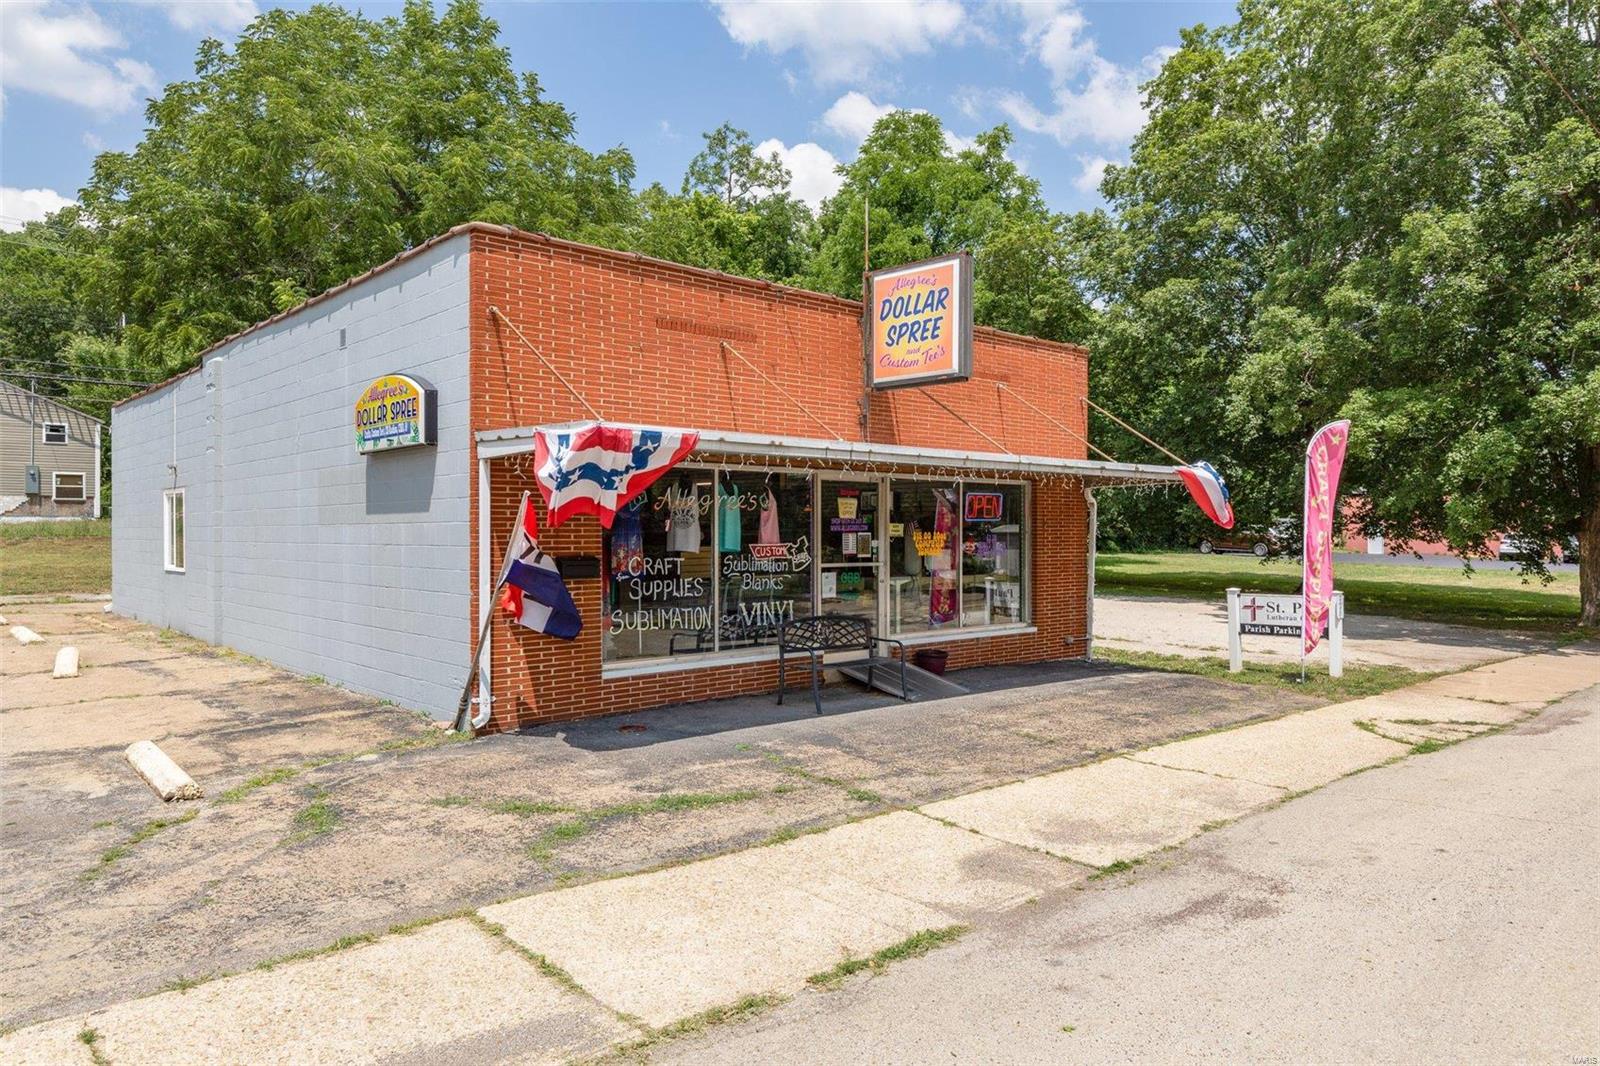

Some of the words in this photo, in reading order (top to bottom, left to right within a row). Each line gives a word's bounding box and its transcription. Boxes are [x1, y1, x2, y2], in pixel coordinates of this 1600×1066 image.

[880, 287, 950, 322] DOLLAR
[885, 316, 944, 347] SPREE
[880, 353, 919, 368] Custom
[922, 345, 945, 364] Tee's
[356, 404, 388, 427] DOLLAR
[390, 397, 417, 420] SPREE
[968, 494, 1001, 518] OPEN
[754, 546, 786, 557] CUSTOM
[628, 556, 685, 577] CRAFT
[723, 554, 789, 574] Sublimation
[628, 578, 704, 601] SUPPLIES
[742, 573, 784, 591] Blanks
[1266, 601, 1285, 613] St.
[609, 605, 713, 635] SUBLIMATION
[1244, 624, 1271, 633] Parish
[1274, 626, 1301, 635] Parkin
